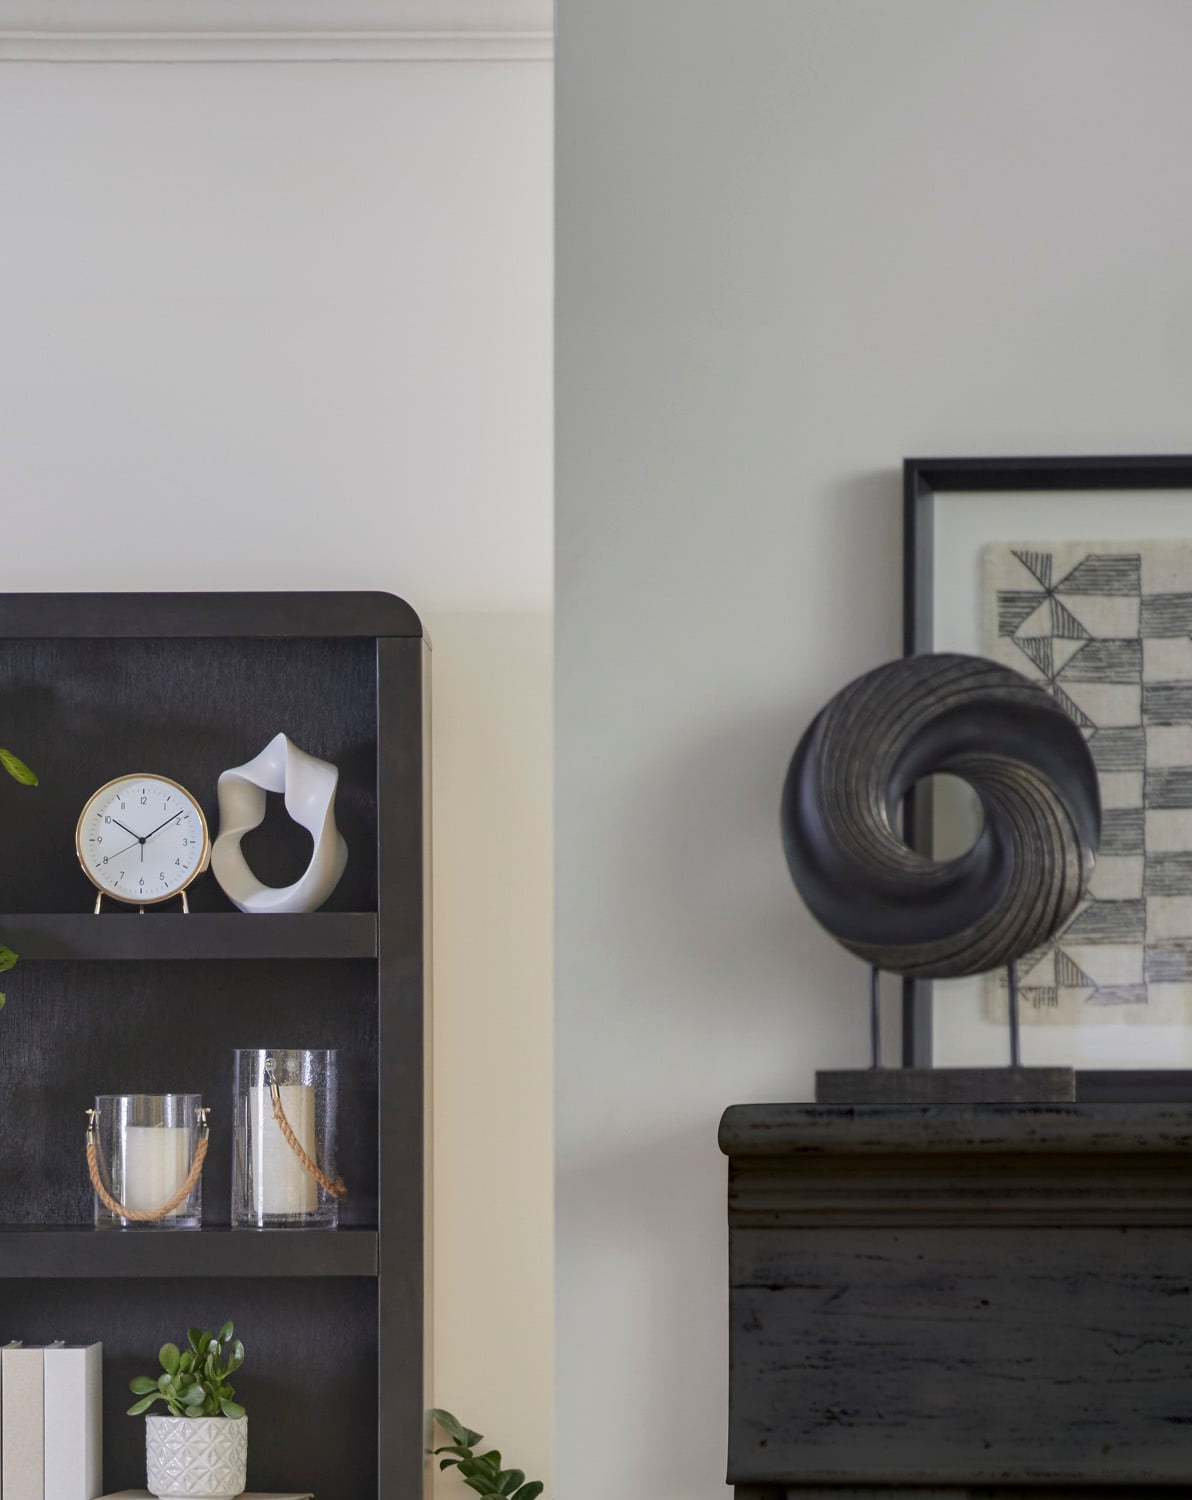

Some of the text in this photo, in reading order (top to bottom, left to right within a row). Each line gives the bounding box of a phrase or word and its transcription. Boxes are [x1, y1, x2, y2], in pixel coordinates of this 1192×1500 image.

[139, 796, 148, 805] 12
[104, 815, 112, 824] 10
[97, 836, 103, 845] 9
[182, 838, 188, 846] 3
[174, 858, 181, 866] 4
[119, 871, 125, 880] 7
[159, 872, 165, 880] 5
[138, 877, 145, 886] 6
